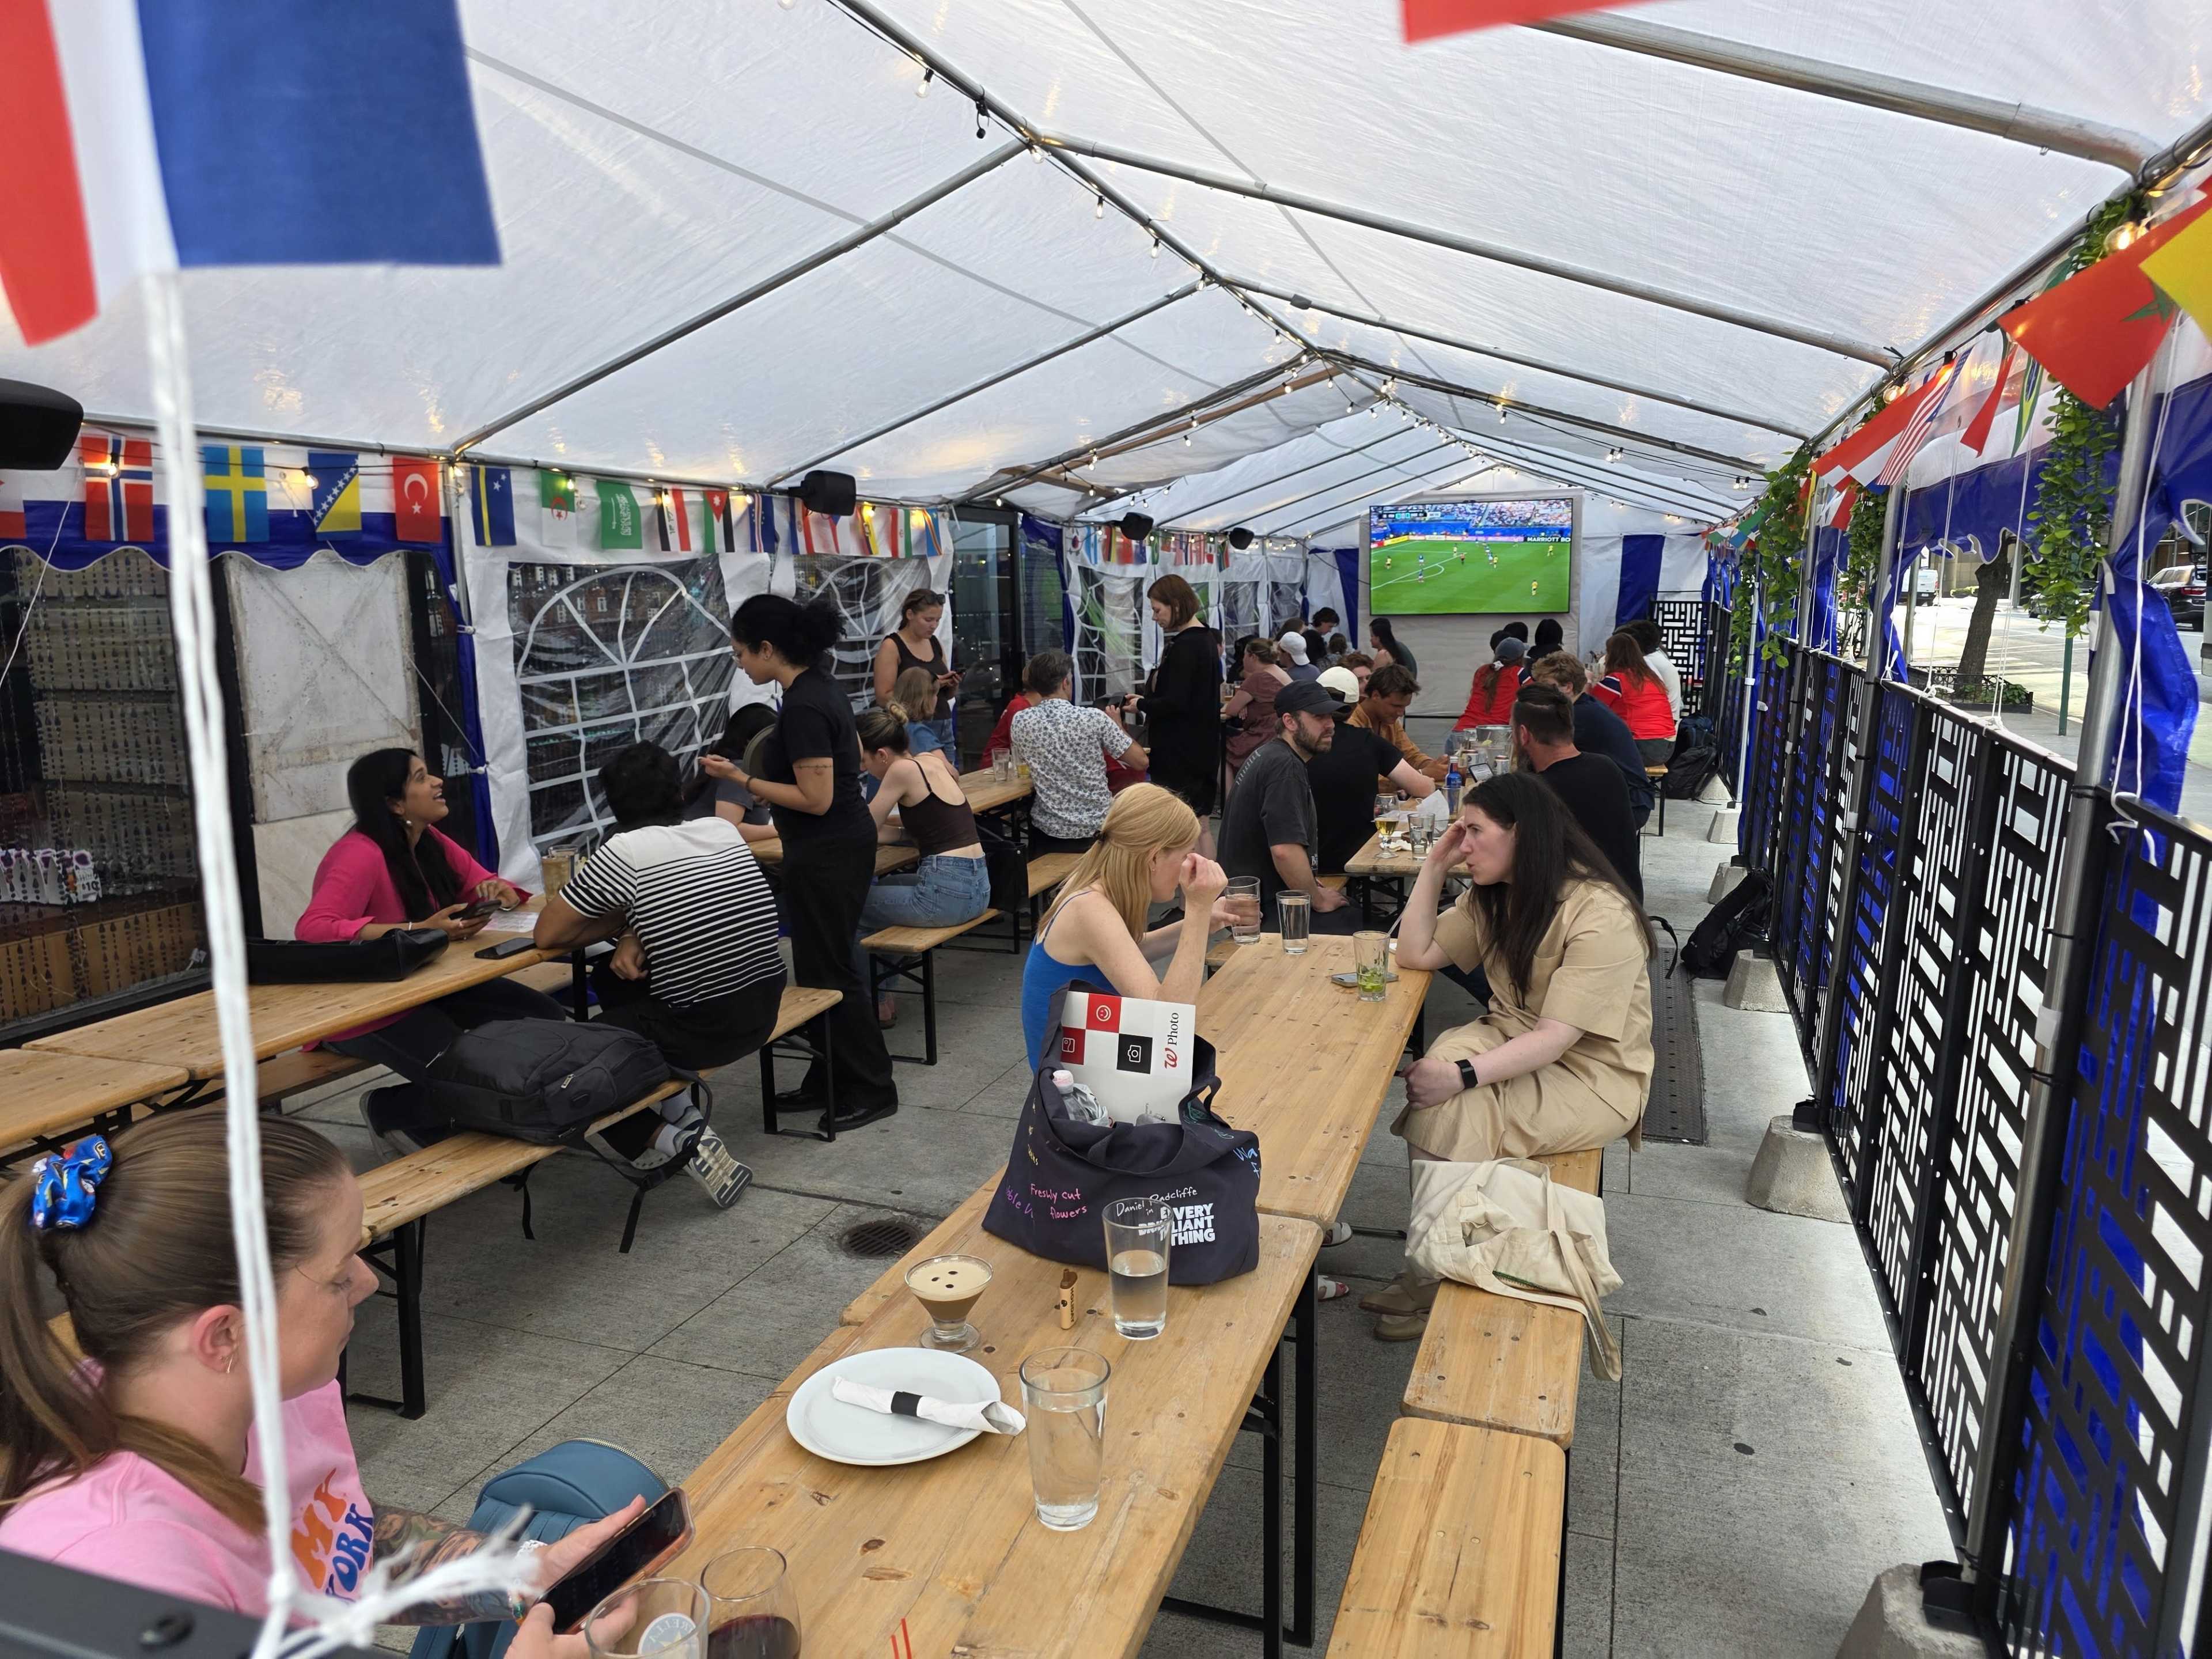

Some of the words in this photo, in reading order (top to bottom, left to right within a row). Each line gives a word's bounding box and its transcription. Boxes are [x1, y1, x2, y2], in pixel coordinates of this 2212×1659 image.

[1167, 1013, 1179, 1046] Photo
[1030, 1183, 1058, 1204] Freshly
[1062, 1188, 1081, 1200] cut
[1116, 1200, 1145, 1217] Daniel
[1149, 1187, 1198, 1203] Radcliffe
[1050, 1205, 1088, 1219] flowers
